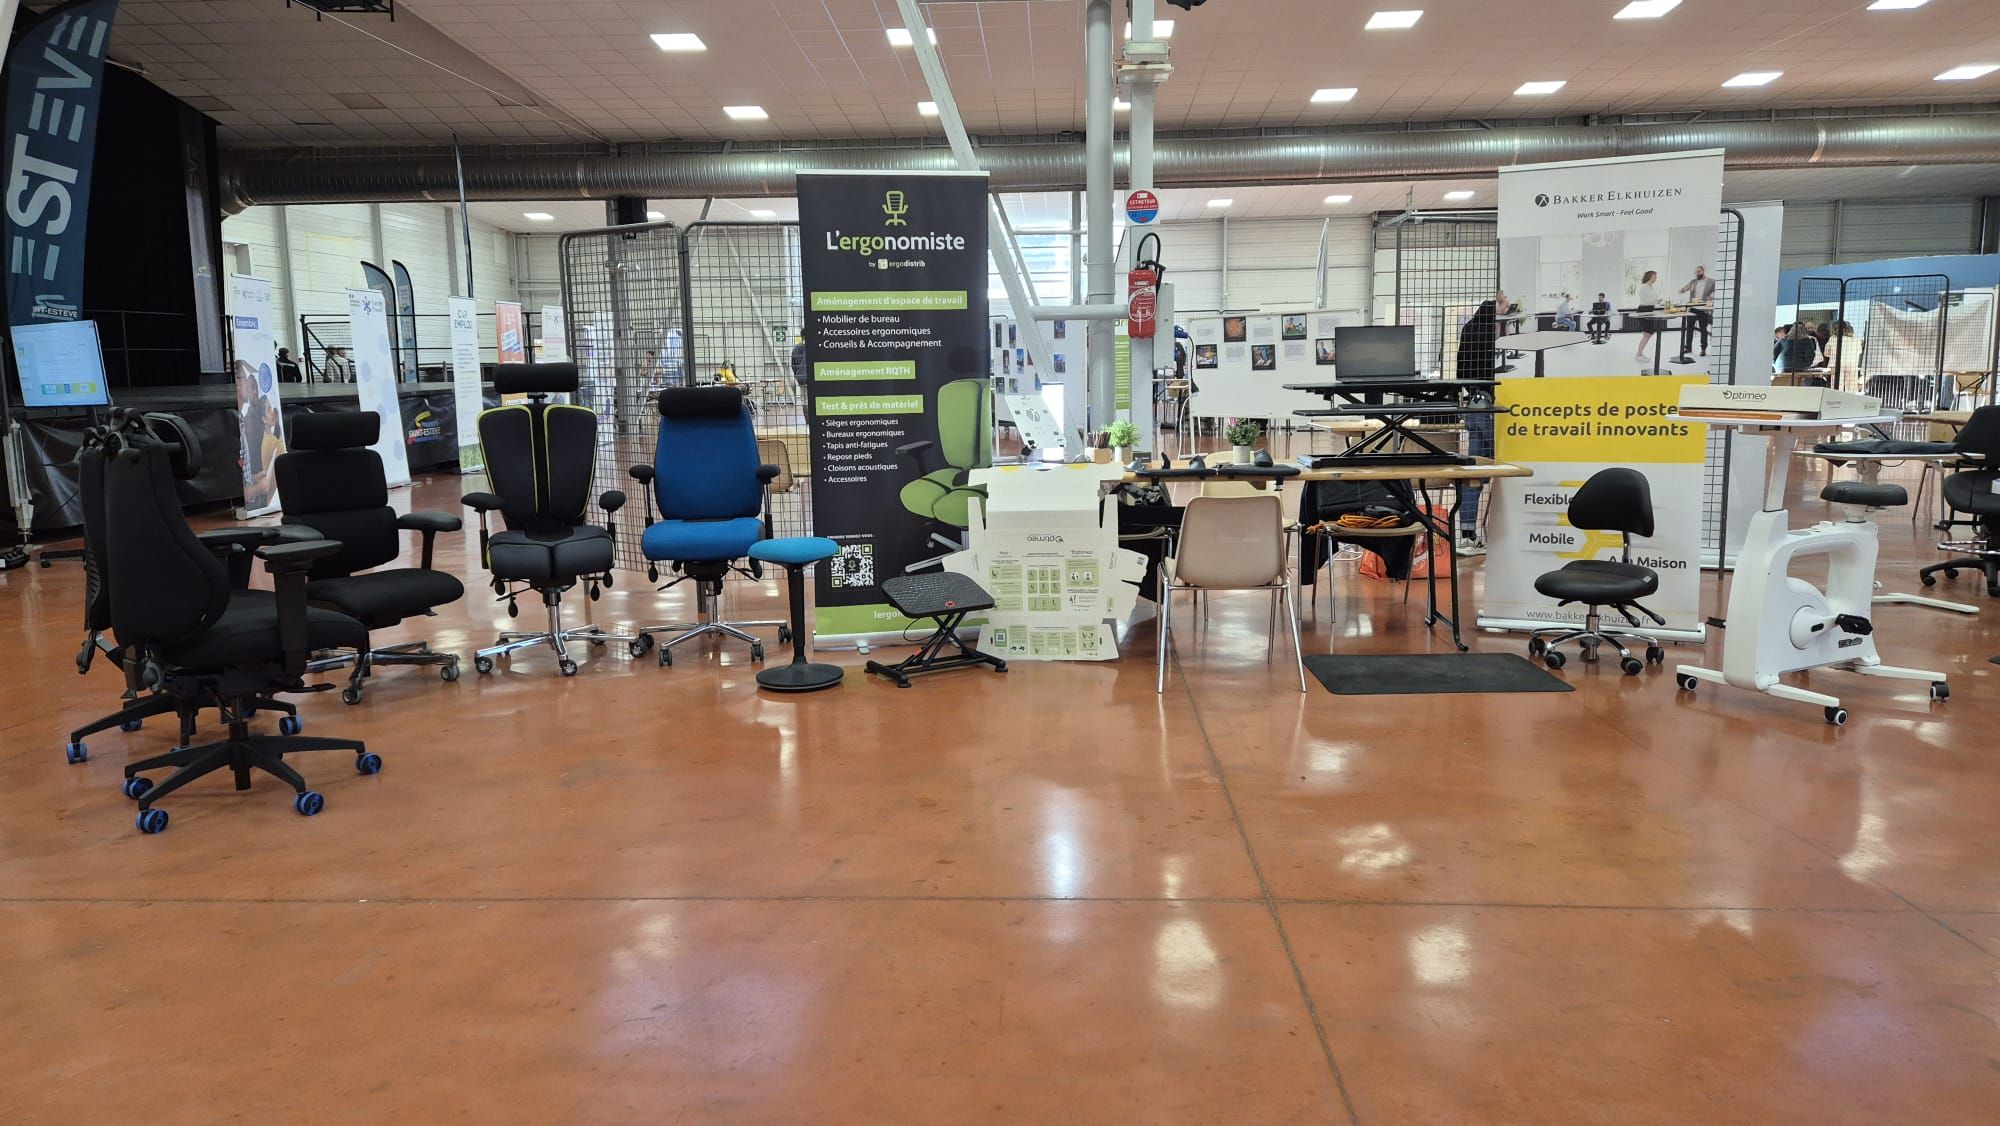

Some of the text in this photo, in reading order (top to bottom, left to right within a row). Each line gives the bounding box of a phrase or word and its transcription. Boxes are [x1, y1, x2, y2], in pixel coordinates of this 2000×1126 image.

[1554, 188, 1682, 204] BAKKER ELKHUIZEN
[826, 230, 965, 256] L'ergonomiste
[889, 260, 926, 268] ergodistrib
[817, 296, 962, 306] Aménagement d'espace de travail
[823, 314, 900, 323] Mobilier de bureau
[823, 327, 931, 337] Accessoires ergonomiques
[823, 340, 857, 348] Conseils
[868, 339, 942, 349] Accompagnement
[820, 367, 910, 377] Aménagement RQTH
[1723, 390, 1767, 400] Optimeo
[822, 400, 918, 412] Test & prêt de matériel
[1509, 403, 1591, 420] Concepts
[1597, 402, 1619, 416] de
[826, 418, 898, 428] Sièges ergonomiques
[856, 429, 904, 438] ergonomiques
[1507, 422, 1688, 436] de travail innovants
[827, 441, 888, 450] Tapis anti-fatigues
[854, 453, 872, 461] pieds
[858, 463, 897, 472] acoustiques
[1027, 534, 1064, 543] Optimeo
[1529, 533, 1575, 545] Mobile
[1638, 556, 1686, 569] Maison
